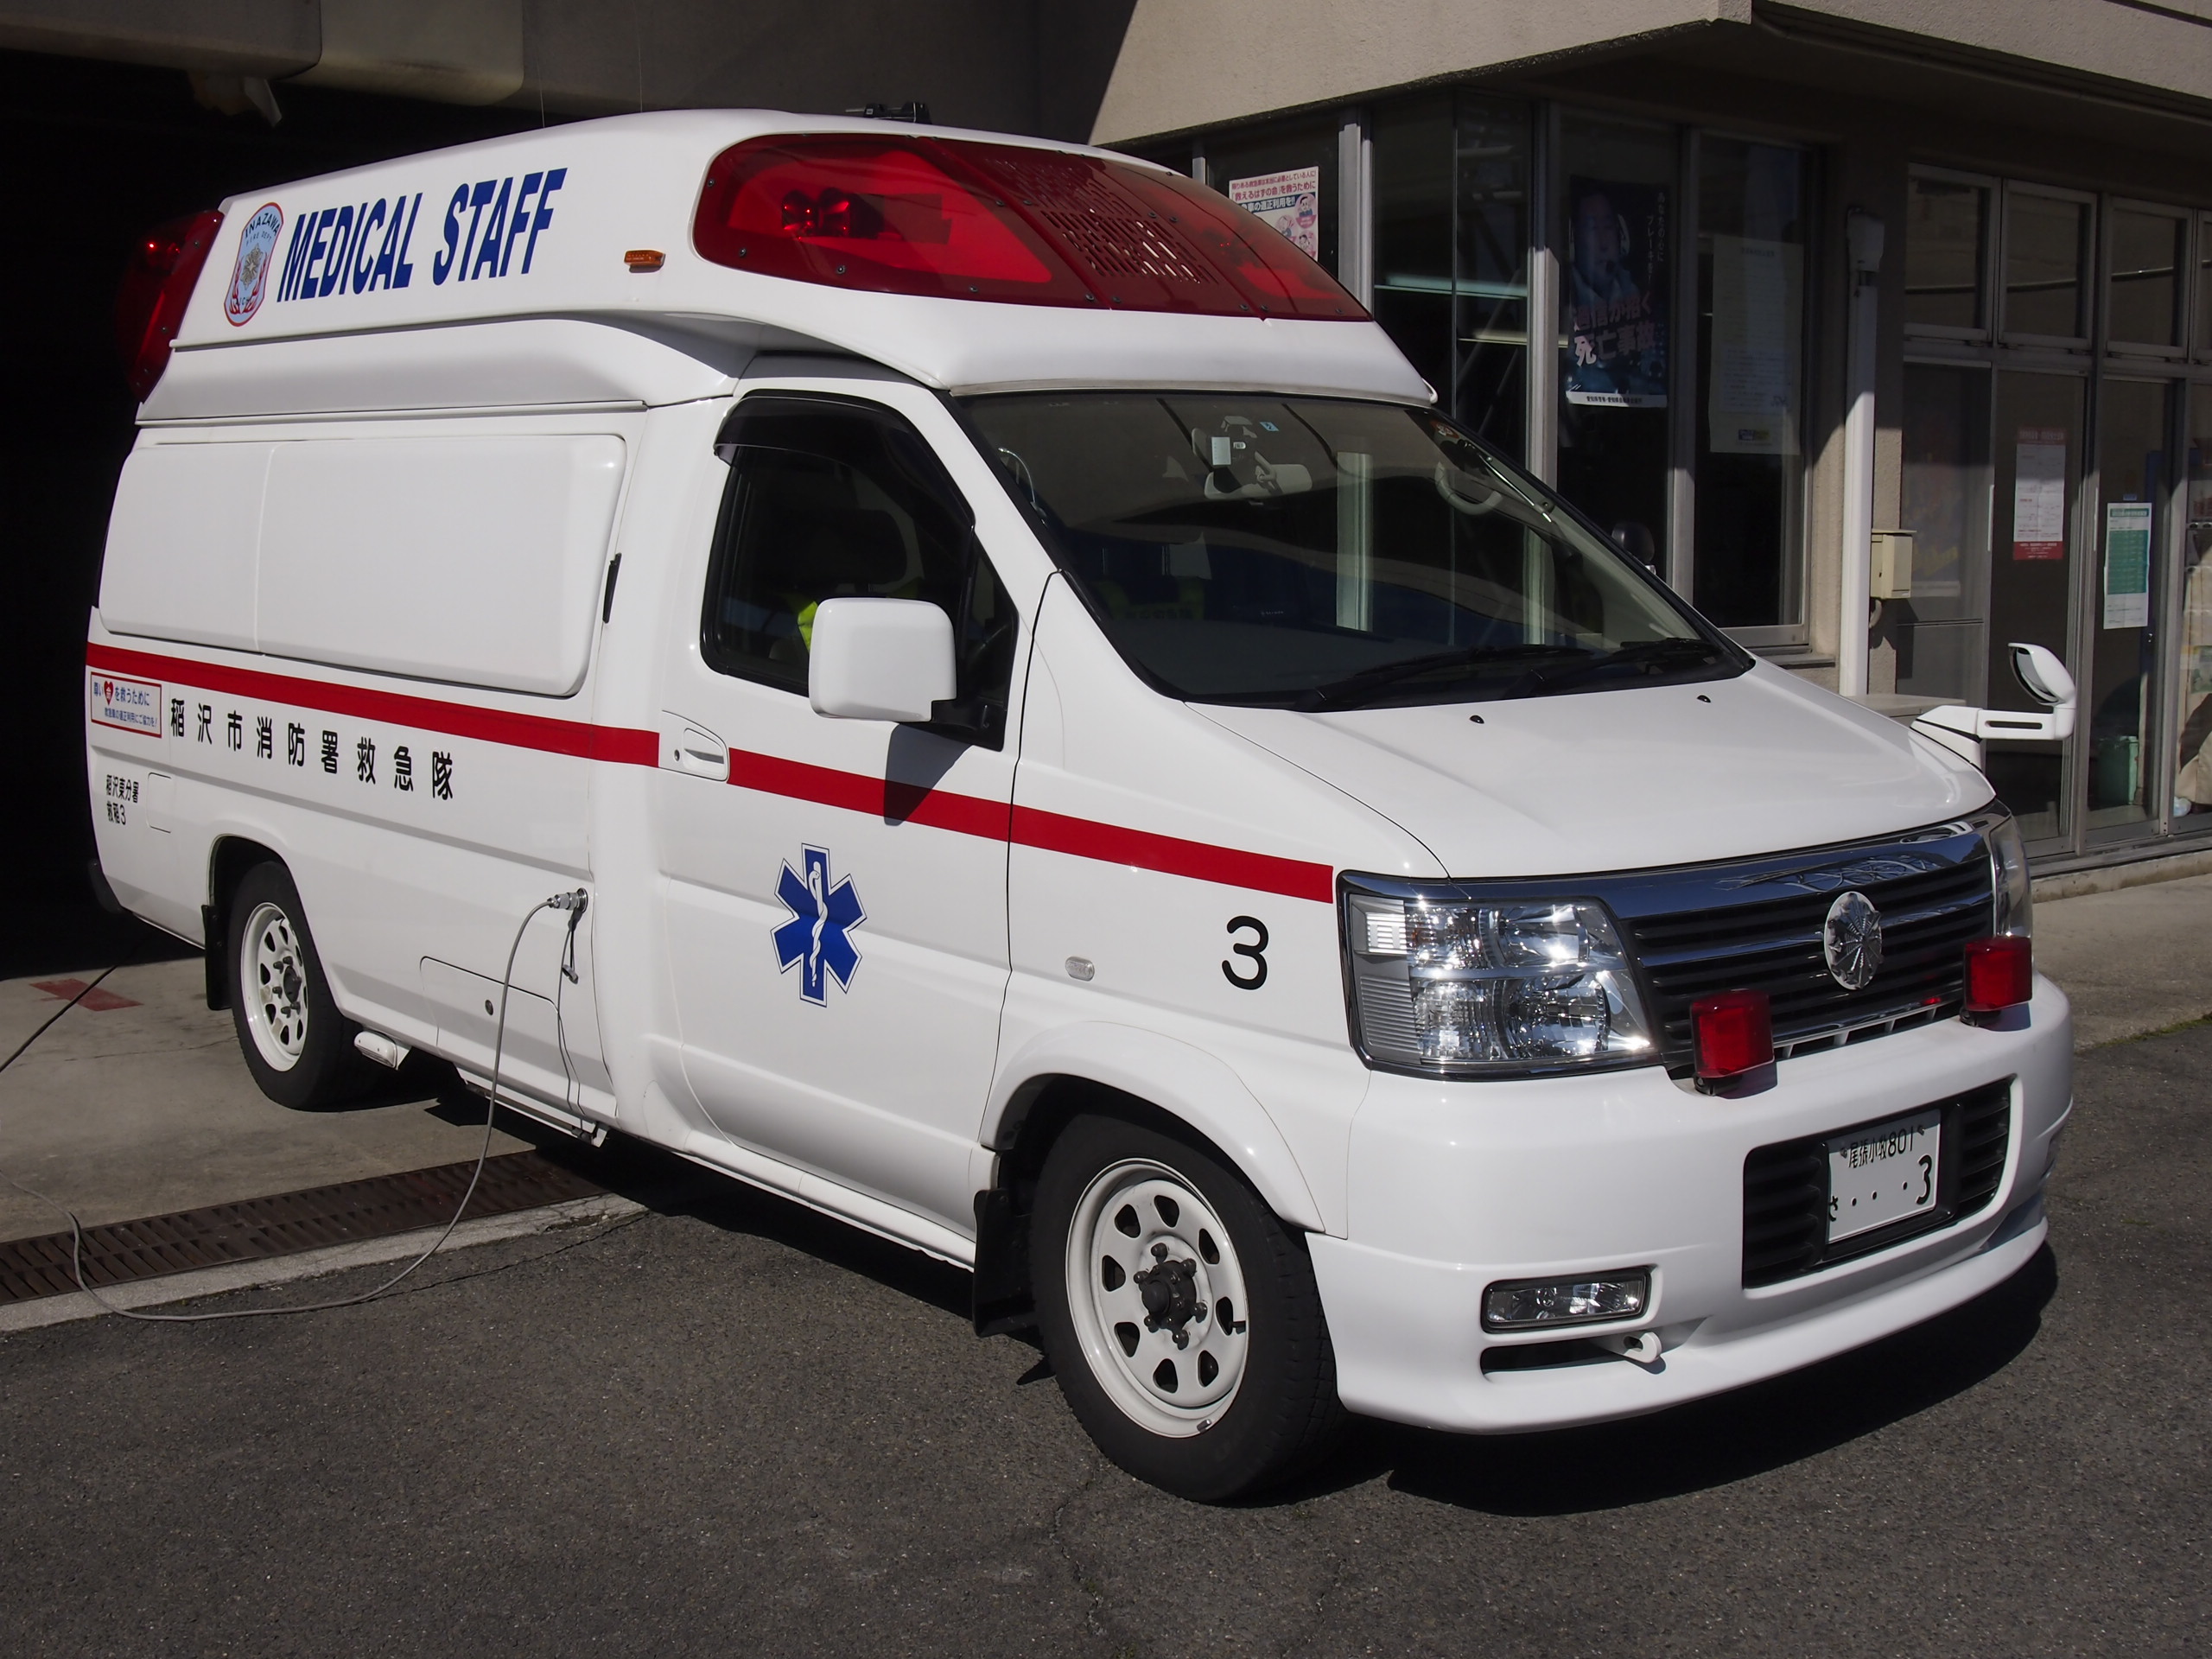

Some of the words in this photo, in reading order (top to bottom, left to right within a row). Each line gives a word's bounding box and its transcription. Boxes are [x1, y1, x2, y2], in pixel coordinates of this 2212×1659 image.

[245, 213, 281, 238] INAZAWA
[246, 232, 260, 247] FIRE
[276, 193, 423, 302] MEDICAL
[433, 168, 568, 286] STAFF
[1573, 319, 1656, 367] 死亡事故
[170, 698, 454, 801] 稲沢市消防署救急隊
[105, 774, 139, 804] 稲沢東分署
[1222, 916, 1268, 990] 3
[1916, 1154, 1933, 1205] 3
